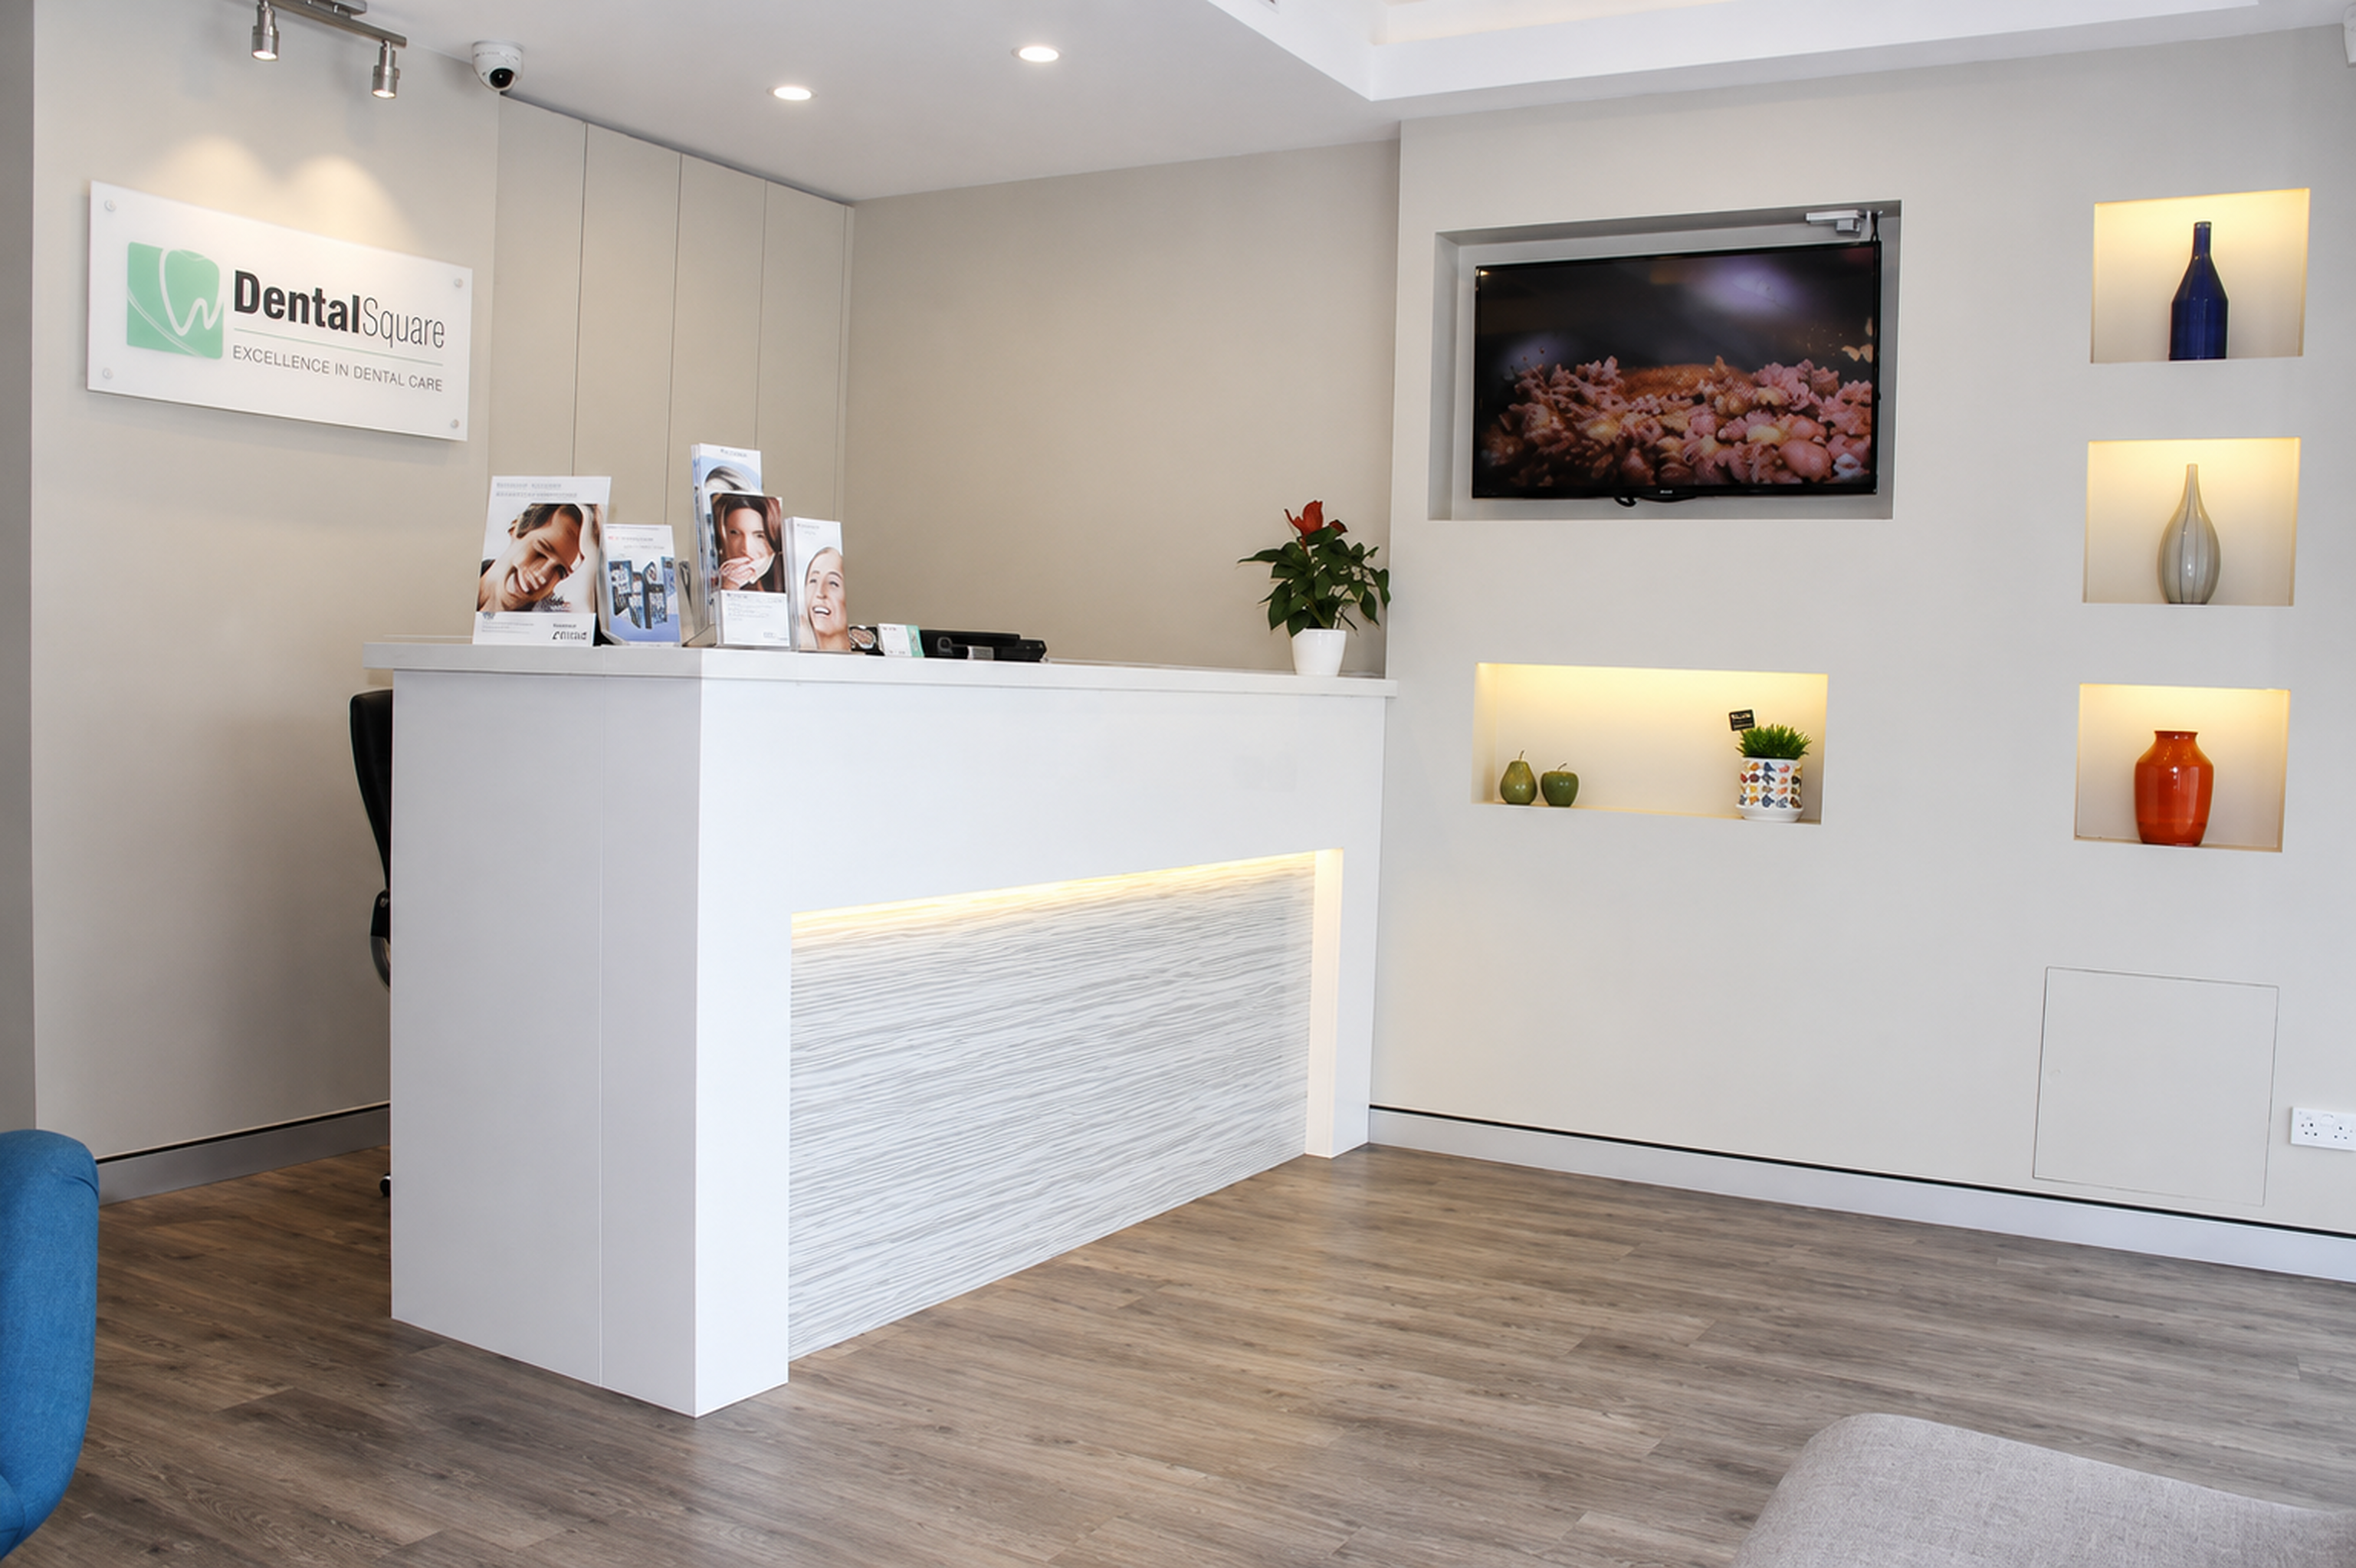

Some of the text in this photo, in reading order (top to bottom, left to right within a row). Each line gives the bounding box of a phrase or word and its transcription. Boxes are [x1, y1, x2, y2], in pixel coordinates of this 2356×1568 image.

[233, 345, 443, 392] EXCELLENCE IN DENTAL CARE
